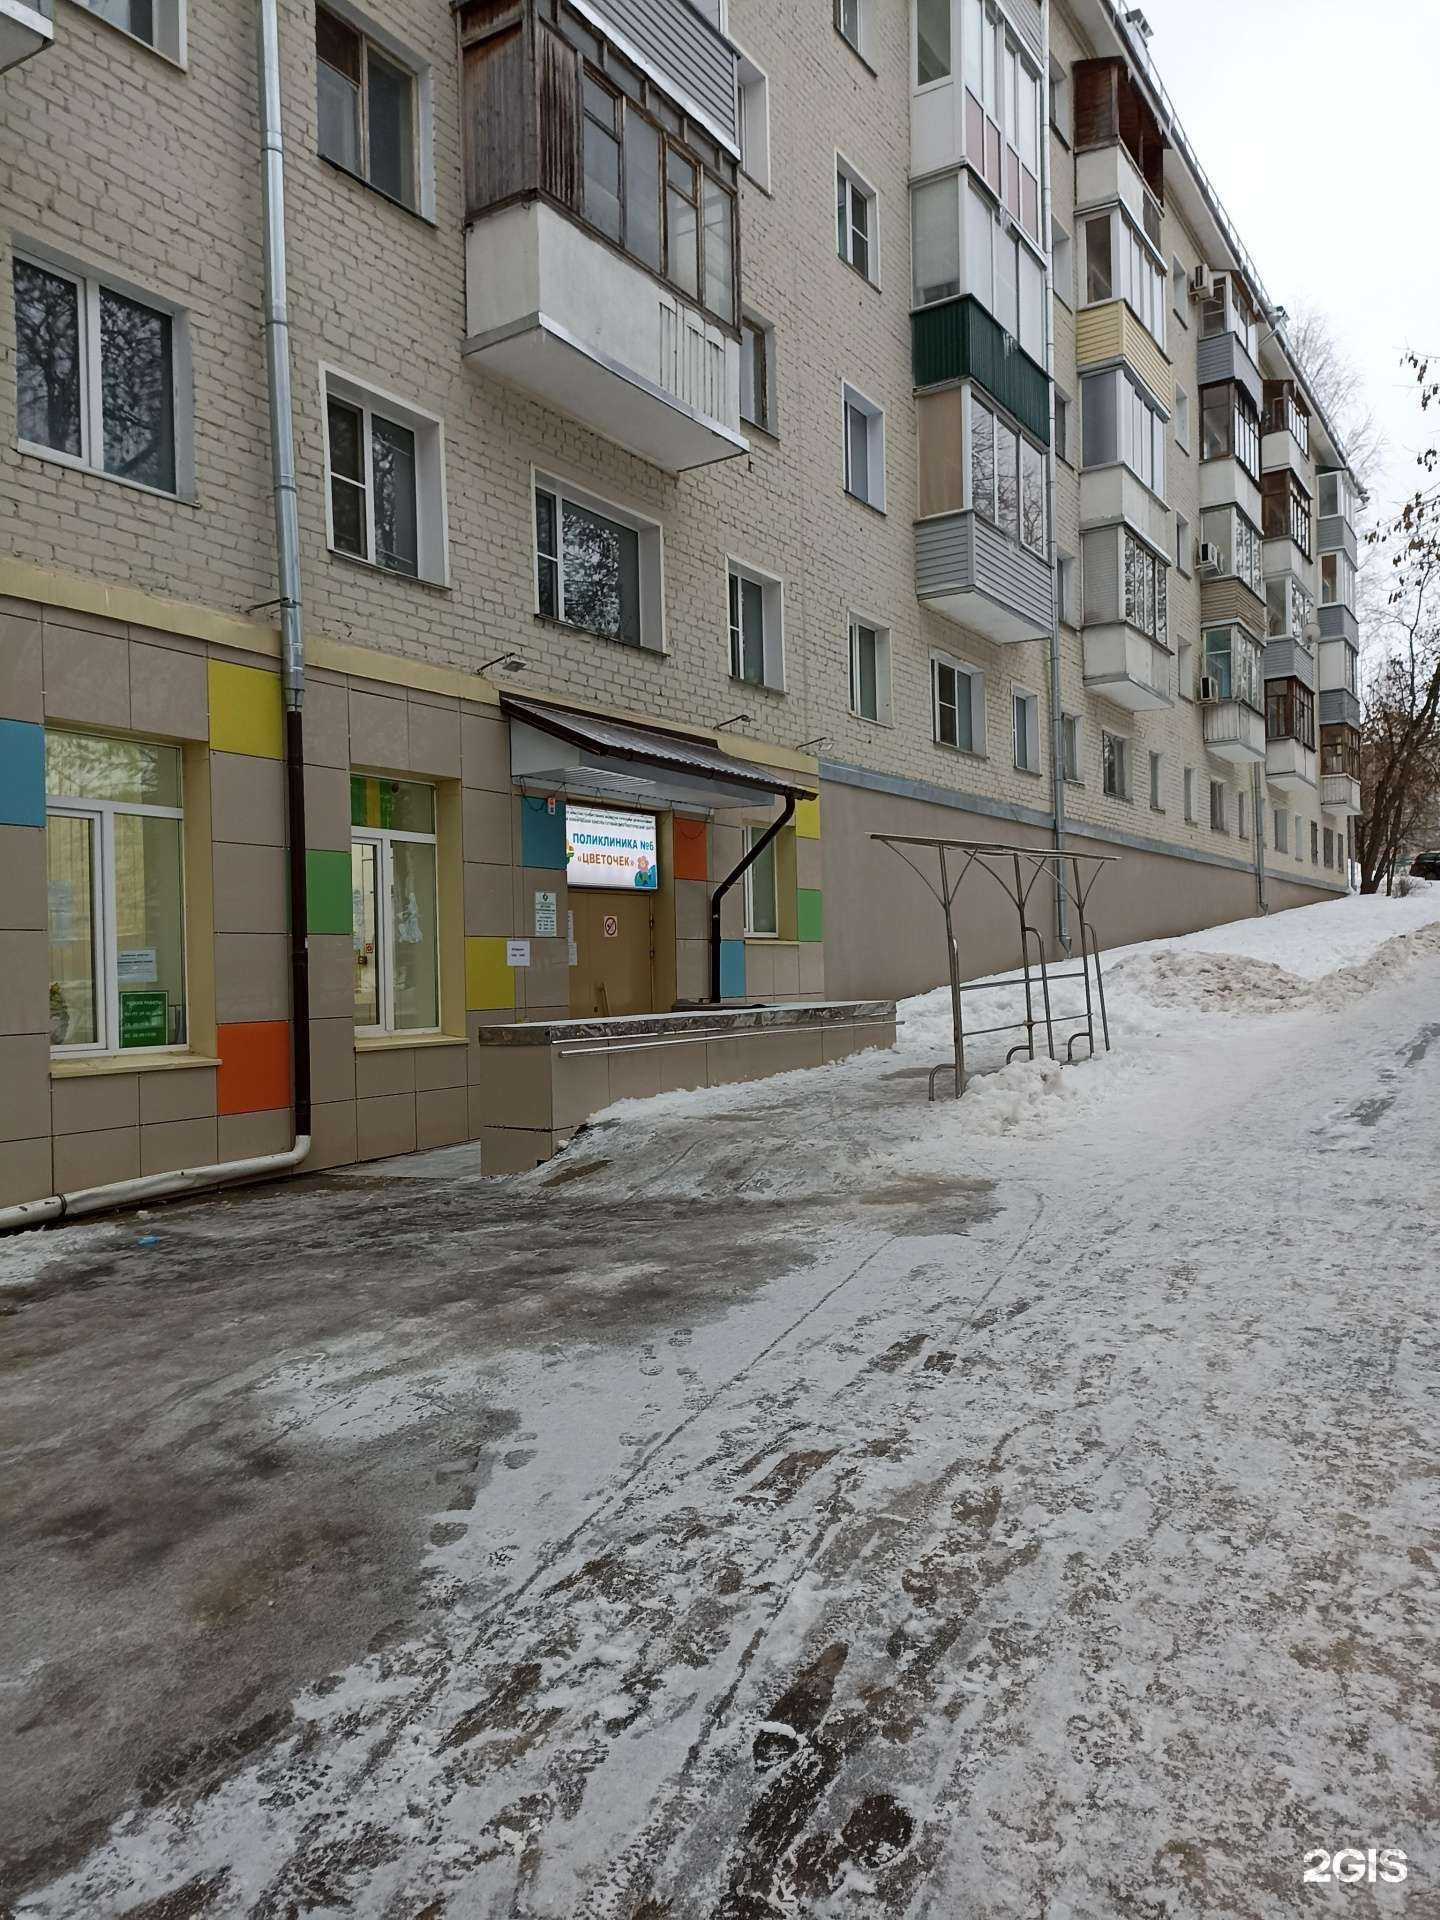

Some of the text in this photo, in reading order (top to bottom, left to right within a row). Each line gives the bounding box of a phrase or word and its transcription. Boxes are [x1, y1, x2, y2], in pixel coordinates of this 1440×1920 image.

[572, 833, 654, 851] ПОЛИКЛИНИКА №6
[577, 853, 635, 867] «ЦВЕТОЧЕК»
